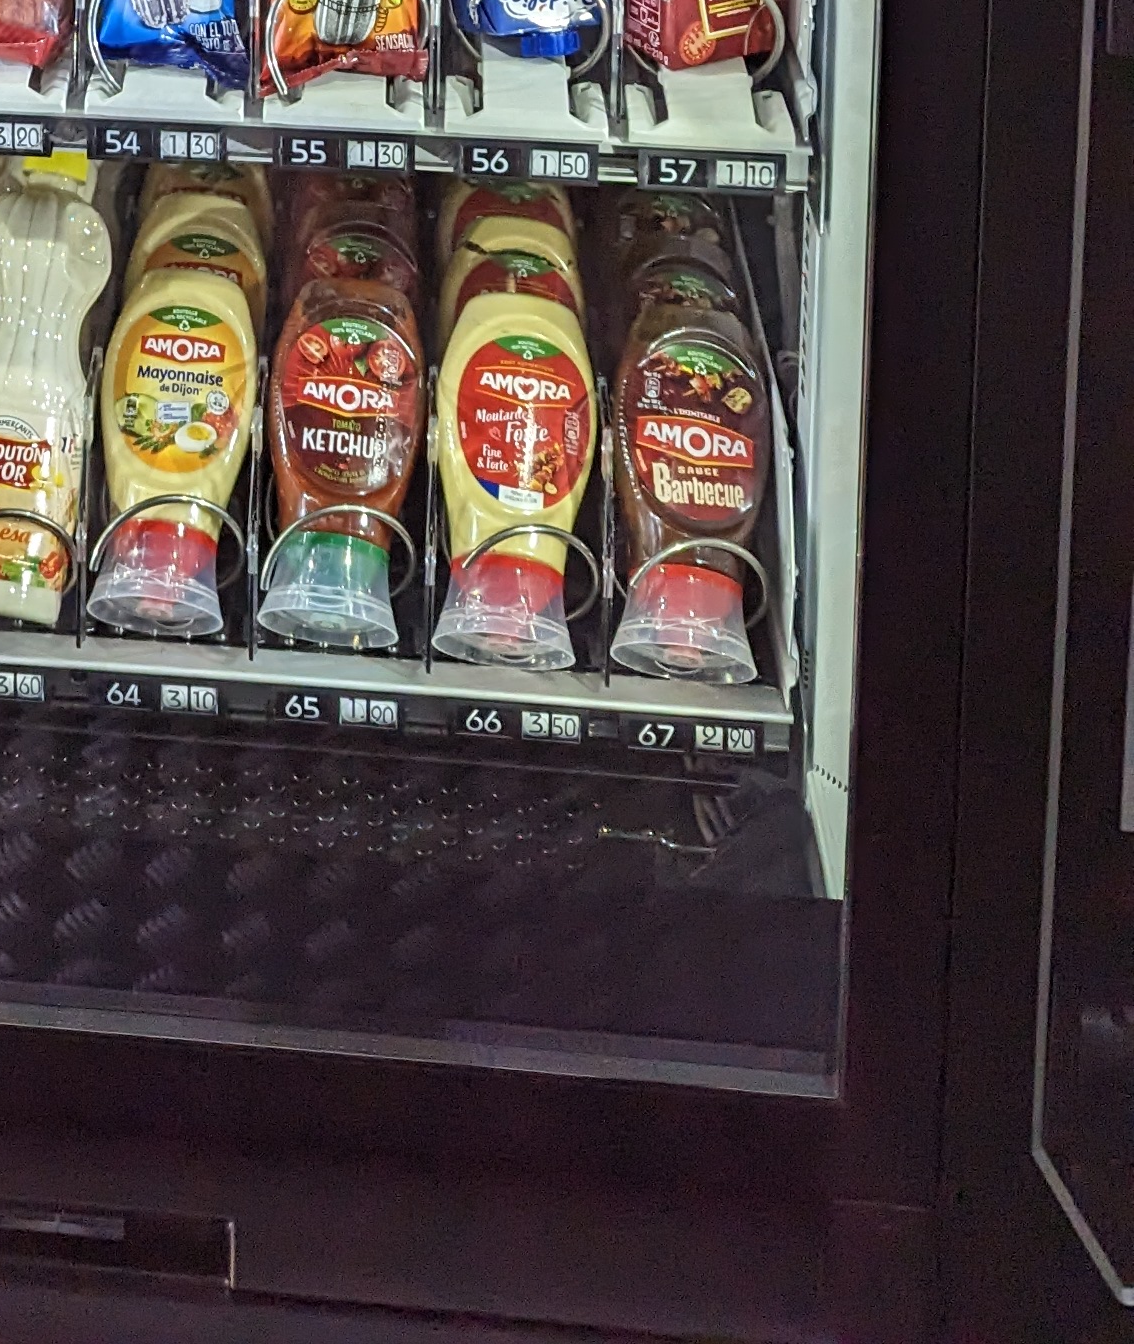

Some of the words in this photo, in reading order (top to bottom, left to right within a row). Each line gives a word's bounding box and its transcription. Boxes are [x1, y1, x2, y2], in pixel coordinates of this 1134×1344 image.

[105, 130, 141, 154] 54
[291, 140, 327, 164] 55
[472, 148, 509, 174] 56
[659, 159, 697, 183] 57
[144, 337, 221, 361] AMORA
[137, 364, 224, 387] Mayonnaise
[303, 380, 394, 411] AMORA
[302, 426, 387, 459] KETCHUP
[643, 421, 748, 458] AMORA
[677, 465, 719, 477] SAUCE
[652, 461, 745, 508] Barbecue
[107, 682, 141, 706] 64
[284, 696, 320, 719] 65
[466, 709, 502, 734] 66
[638, 723, 675, 748] 67
